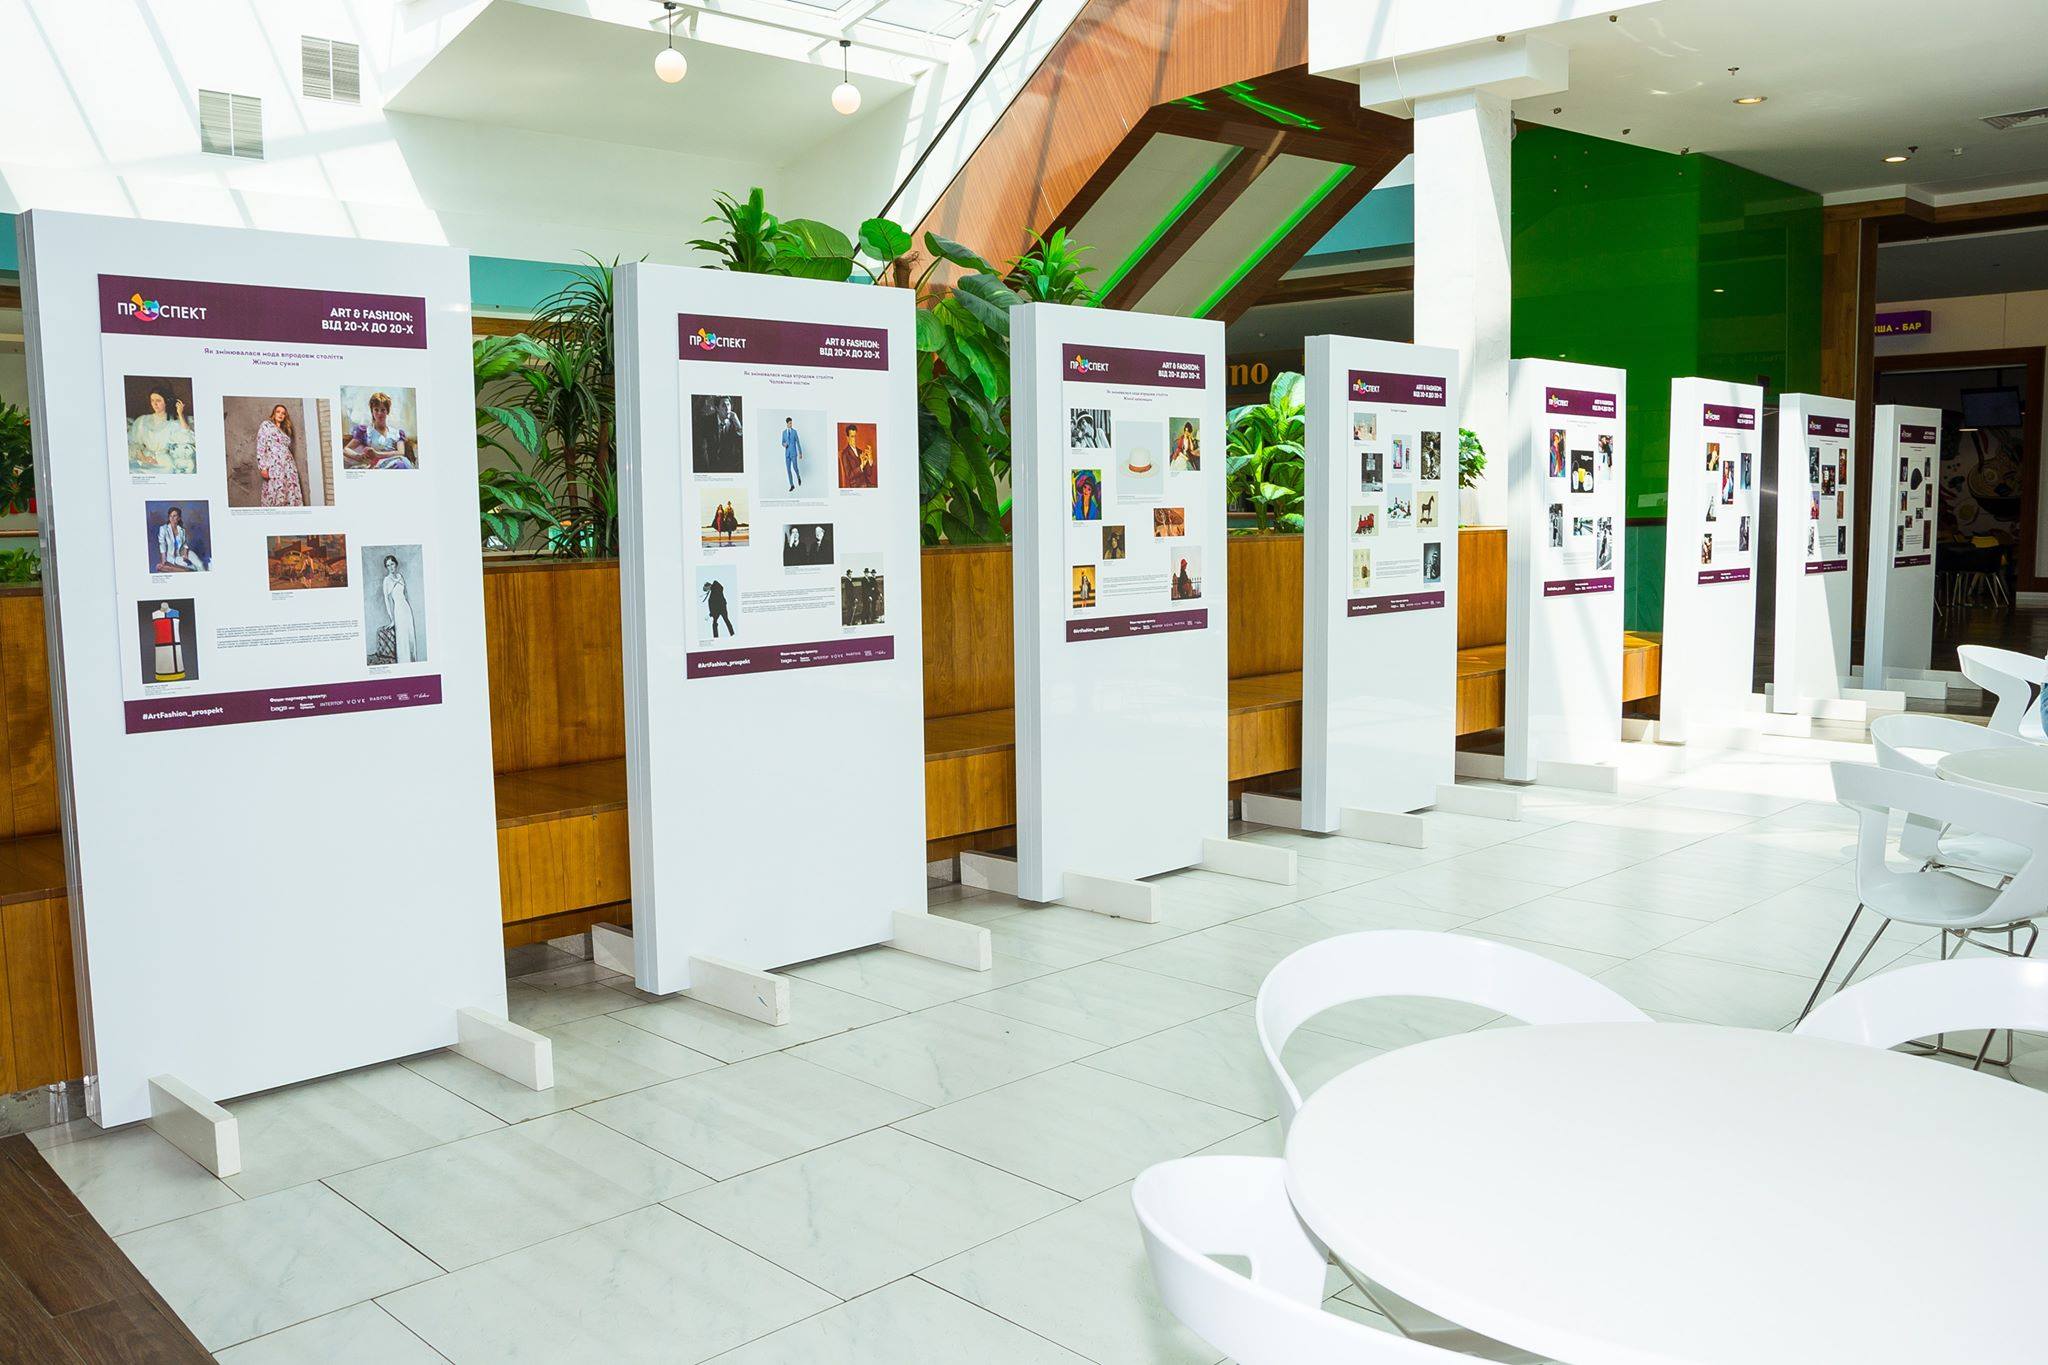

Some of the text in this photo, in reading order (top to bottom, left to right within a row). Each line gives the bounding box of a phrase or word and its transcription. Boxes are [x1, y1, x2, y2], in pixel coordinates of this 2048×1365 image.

[330, 307, 413, 322] ART & FASHION:
[321, 320, 342, 332] ВІД
[371, 323, 388, 333] ДО
[1902, 322, 1922, 331] БАР
[825, 337, 840, 346] ART
[846, 339, 880, 349] FASHION:
[819, 347, 834, 357] ВІД
[851, 349, 863, 358] ДО
[142, 706, 224, 721] #ArtFashion_prospekt
